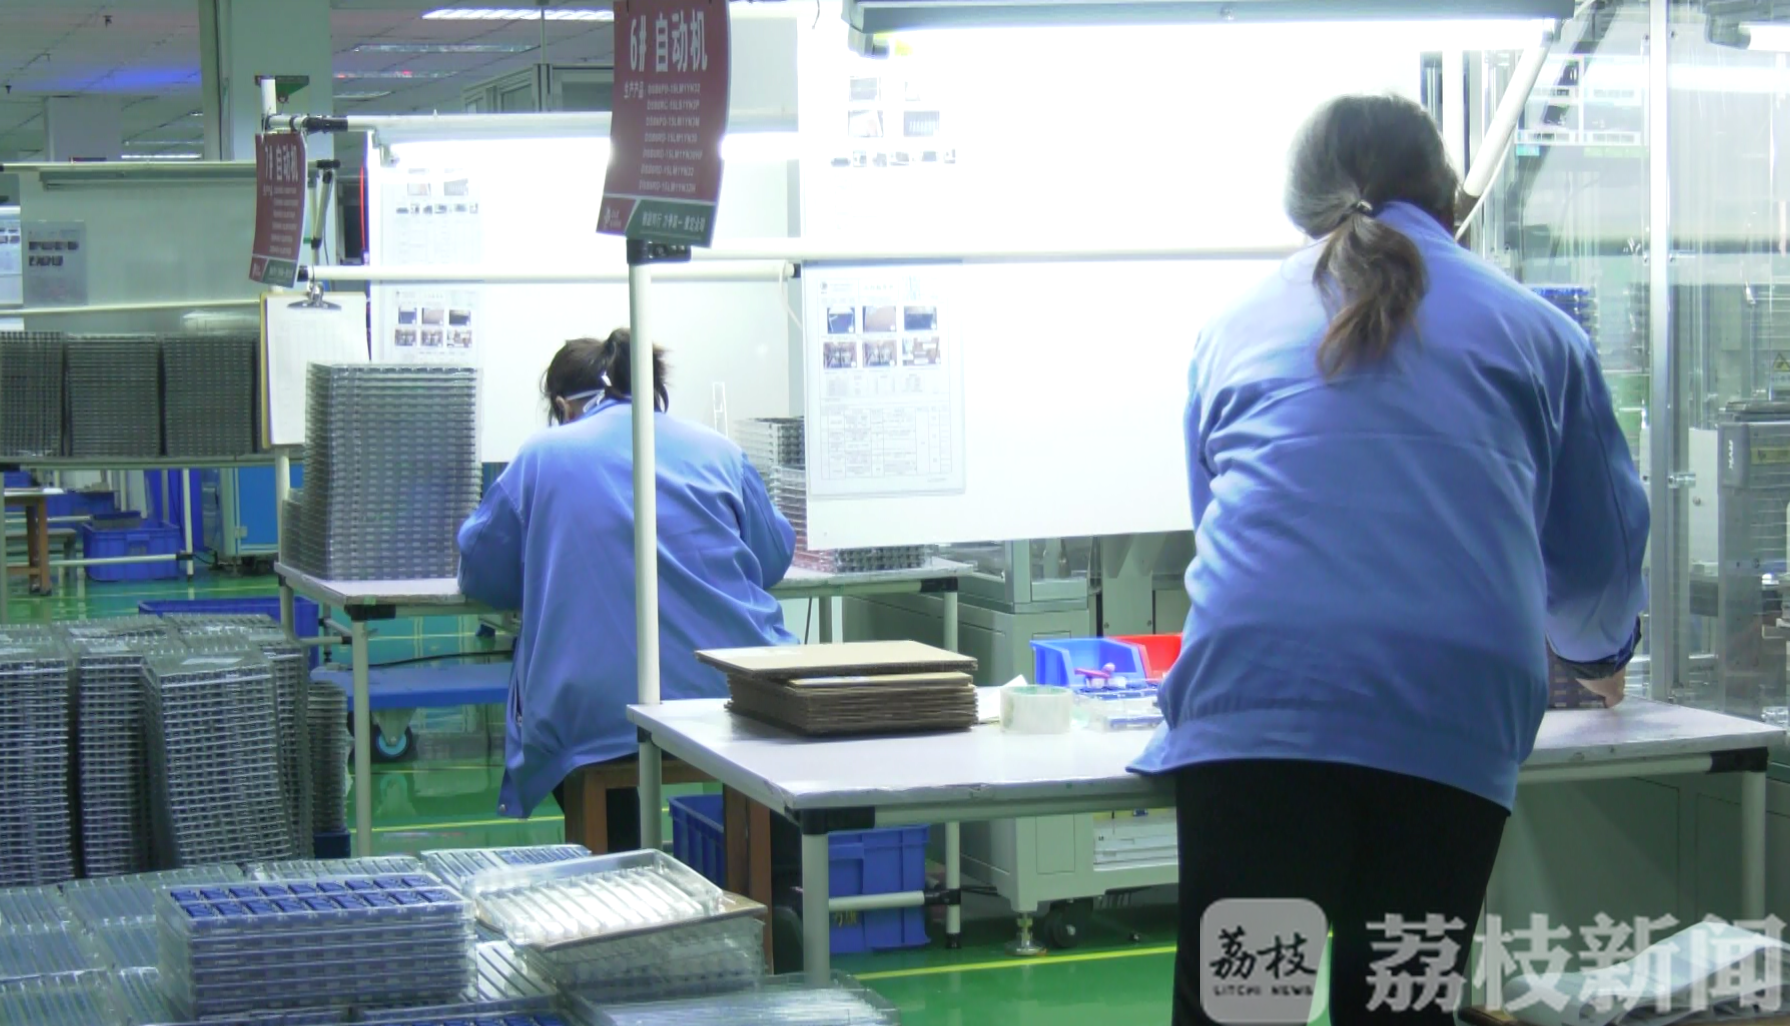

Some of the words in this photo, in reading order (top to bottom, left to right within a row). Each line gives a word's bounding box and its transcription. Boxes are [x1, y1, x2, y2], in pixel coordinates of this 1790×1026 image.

[630, 15, 646, 71] 6#
[656, 9, 708, 72] 自动机
